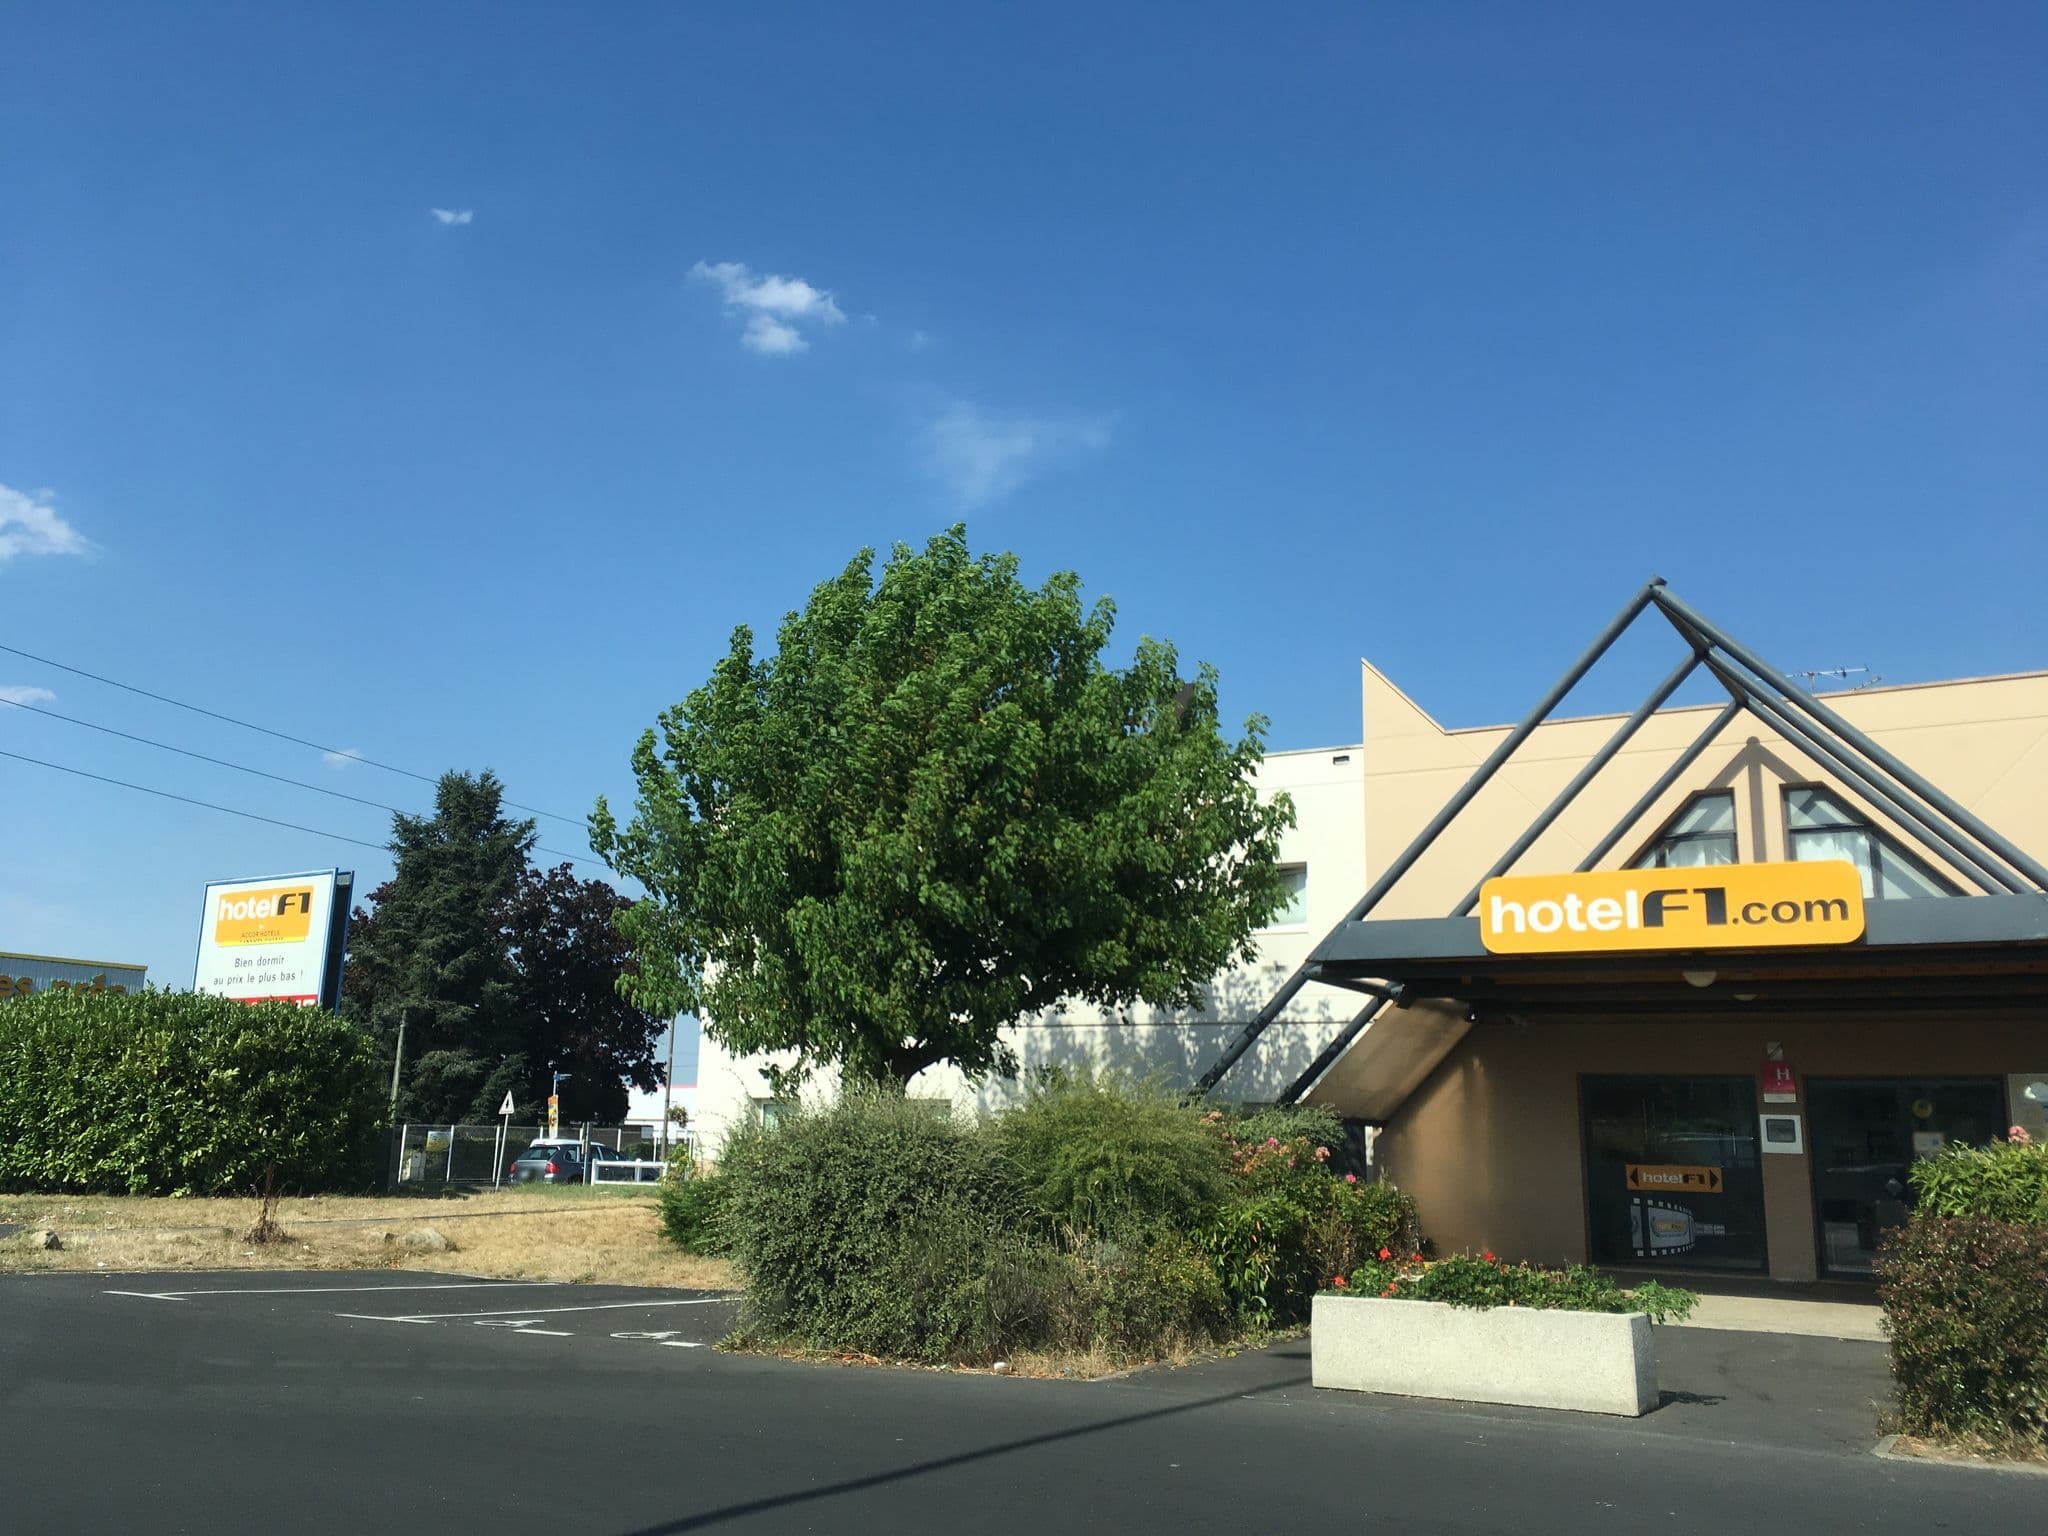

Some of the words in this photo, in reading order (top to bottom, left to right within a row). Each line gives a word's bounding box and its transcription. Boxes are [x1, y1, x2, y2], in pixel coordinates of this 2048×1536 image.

[219, 892, 311, 921] hotelF1
[1491, 887, 1849, 934] hotelF1.com
[234, 958, 253, 968] Bien
[257, 955, 285, 967] dormir
[213, 977, 224, 985] au
[227, 975, 243, 986] prix
[247, 973, 255, 983] le
[258, 972, 277, 984] plus
[1776, 1068, 1791, 1081] H
[1642, 1172, 1706, 1185] hotelF1
